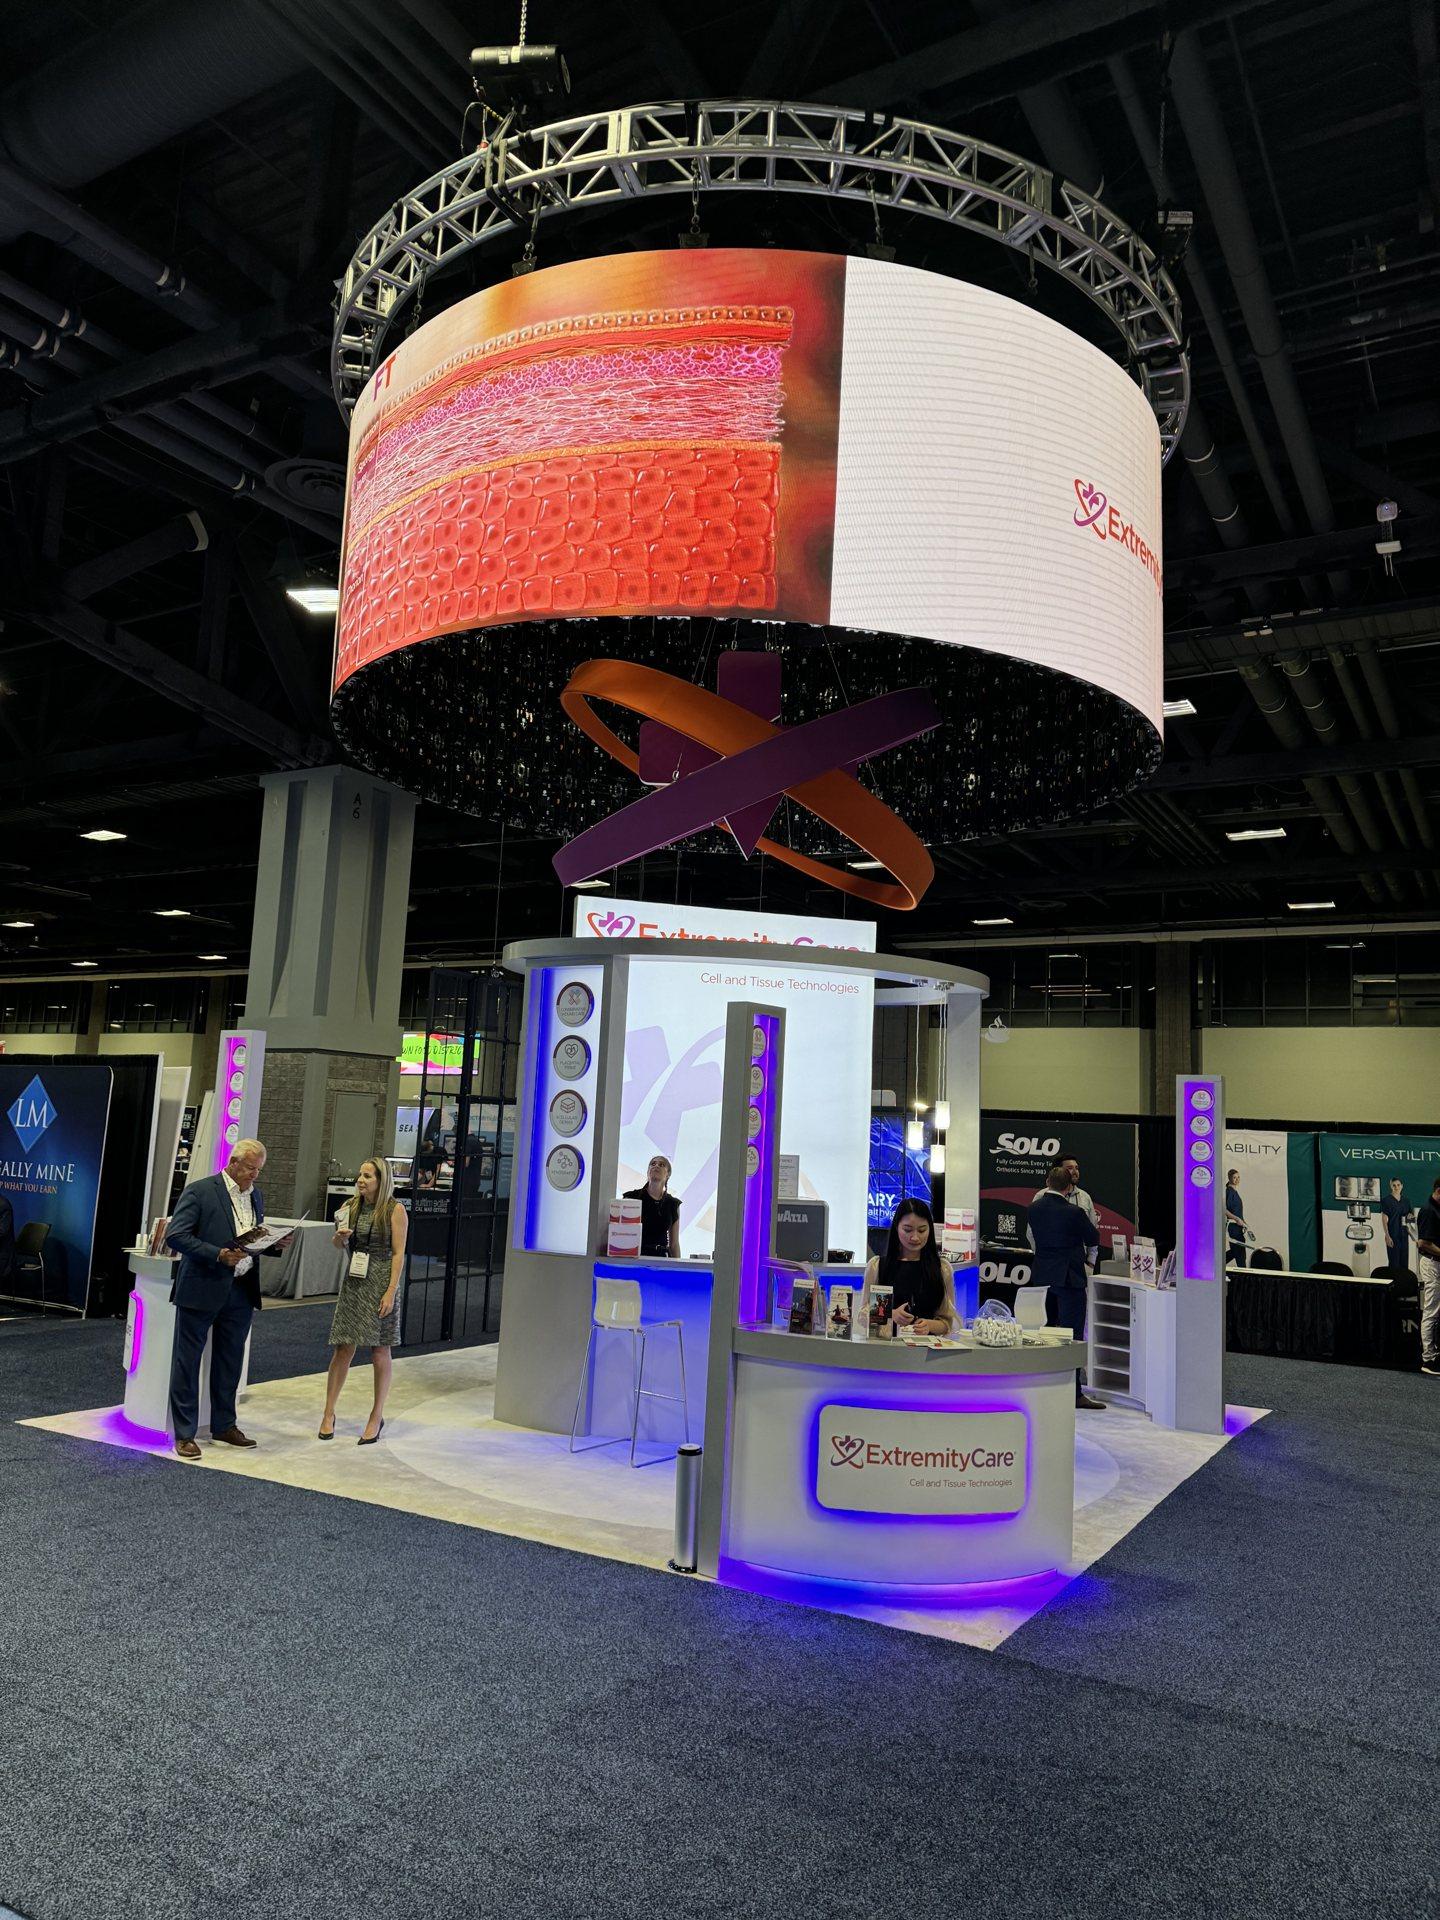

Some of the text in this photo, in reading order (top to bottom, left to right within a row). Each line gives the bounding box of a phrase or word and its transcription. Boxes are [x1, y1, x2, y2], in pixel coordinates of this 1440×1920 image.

[373, 353, 397, 402] FT
[352, 792, 362, 819] A 6
[700, 972, 859, 994] Cell and Tissue Technologies
[433, 1045, 463, 1055] DISTRIC
[15, 1098, 48, 1129] LM
[398, 1124, 414, 1133] SEA
[994, 1132, 1061, 1157] SOLO
[1225, 1143, 1282, 1155] ABILITY
[35, 1163, 75, 1182] MINE
[996, 1158, 1008, 1166] Fully
[1030, 1160, 1045, 1168] Every
[5, 1182, 23, 1192] WHAT
[24, 1183, 40, 1193] YOU
[40, 1184, 57, 1194] EARN
[866, 1443, 1014, 1473] ExtremityCare
[909, 1478, 1012, 1489] Cell and Tissue Technologies
